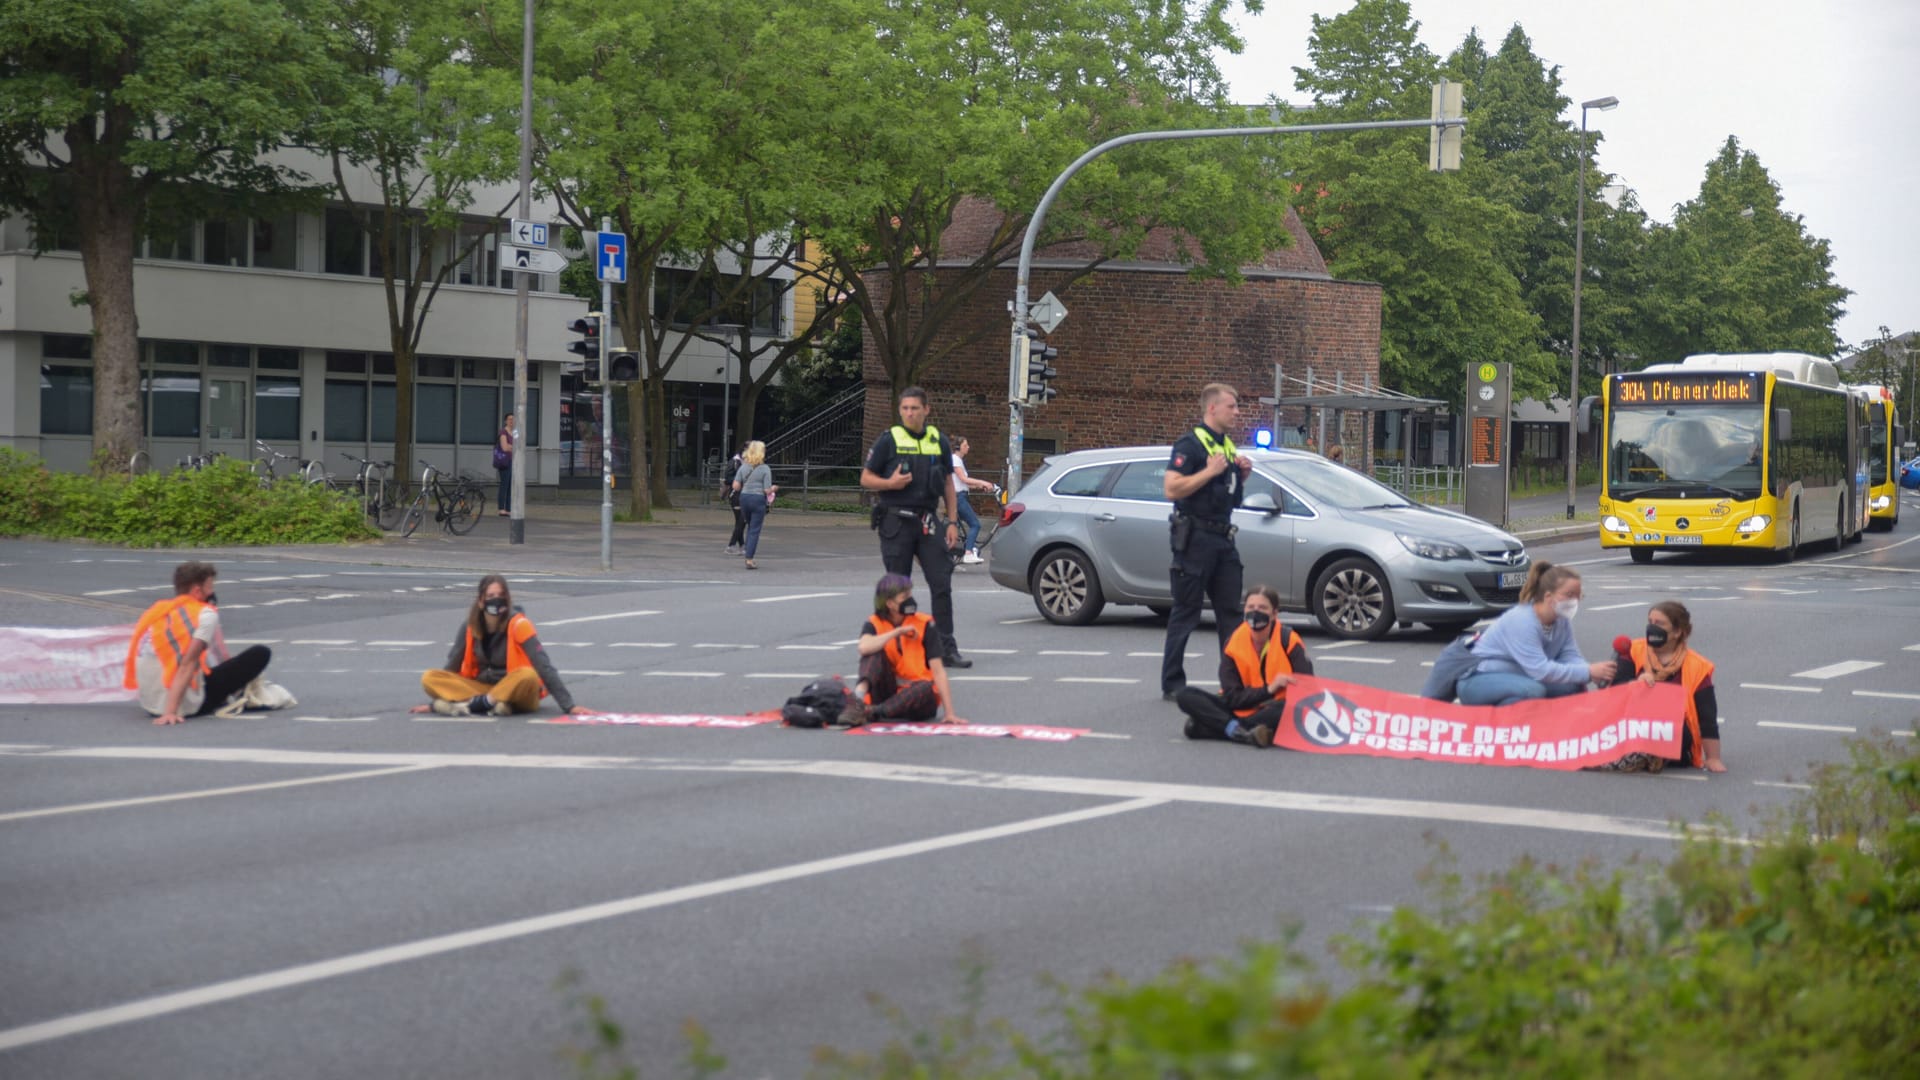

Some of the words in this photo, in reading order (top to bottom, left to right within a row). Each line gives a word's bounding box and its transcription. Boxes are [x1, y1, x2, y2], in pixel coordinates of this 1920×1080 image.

[1620, 381, 1646, 401] 304
[1652, 379, 1750, 401] Ofenerdiek
[1349, 732, 1496, 759] FOSSILEN
[1503, 719, 1674, 762] WAHNSINN
[1352, 708, 1468, 744] STOPPT
[1473, 725, 1531, 745] DEN
